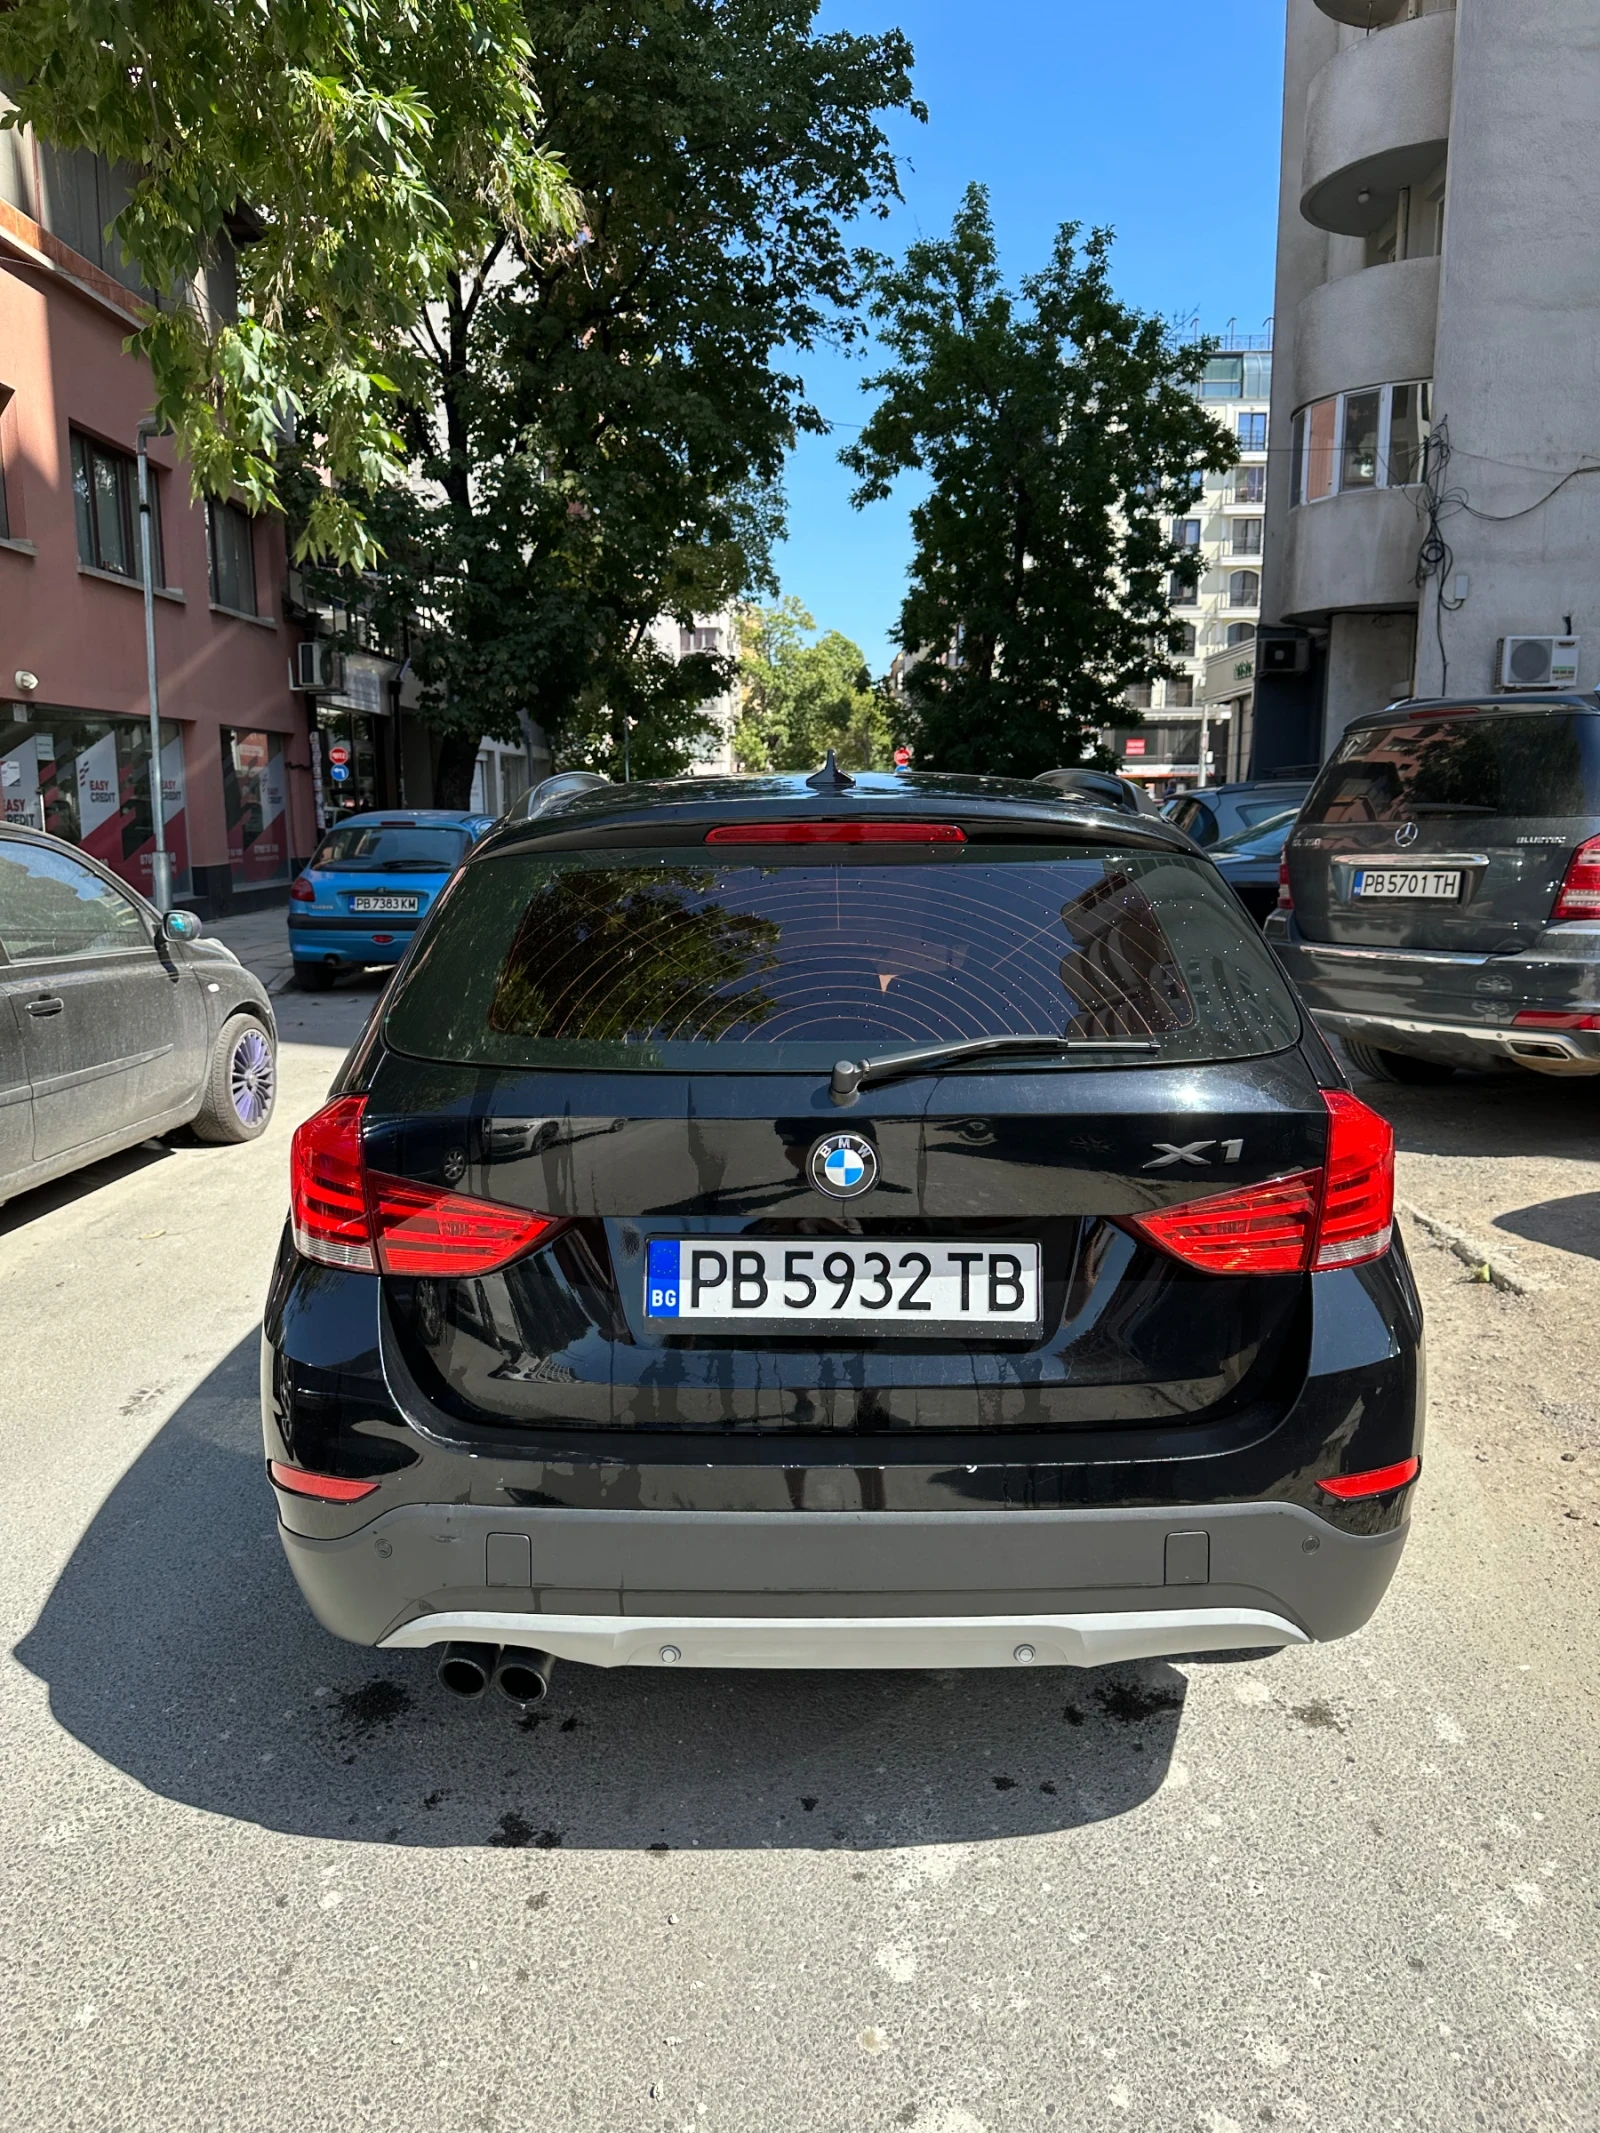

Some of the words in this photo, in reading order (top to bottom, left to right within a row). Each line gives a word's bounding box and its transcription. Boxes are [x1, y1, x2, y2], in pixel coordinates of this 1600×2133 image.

[90, 780, 109, 791] EASY
[90, 792, 116, 803] CREDIT
[1363, 875, 1385, 893] PB
[1388, 875, 1427, 894] 5701
[1434, 875, 1457, 895] TH
[356, 898, 371, 909] PB
[372, 898, 399, 909] 7383
[401, 898, 416, 909] KM
[819, 1137, 872, 1159] BMW
[1142, 1139, 1244, 1168] X1
[690, 1250, 769, 1309] PB
[783, 1250, 932, 1311] 5932
[947, 1252, 1025, 1312] TB
[651, 1289, 677, 1307] BG
